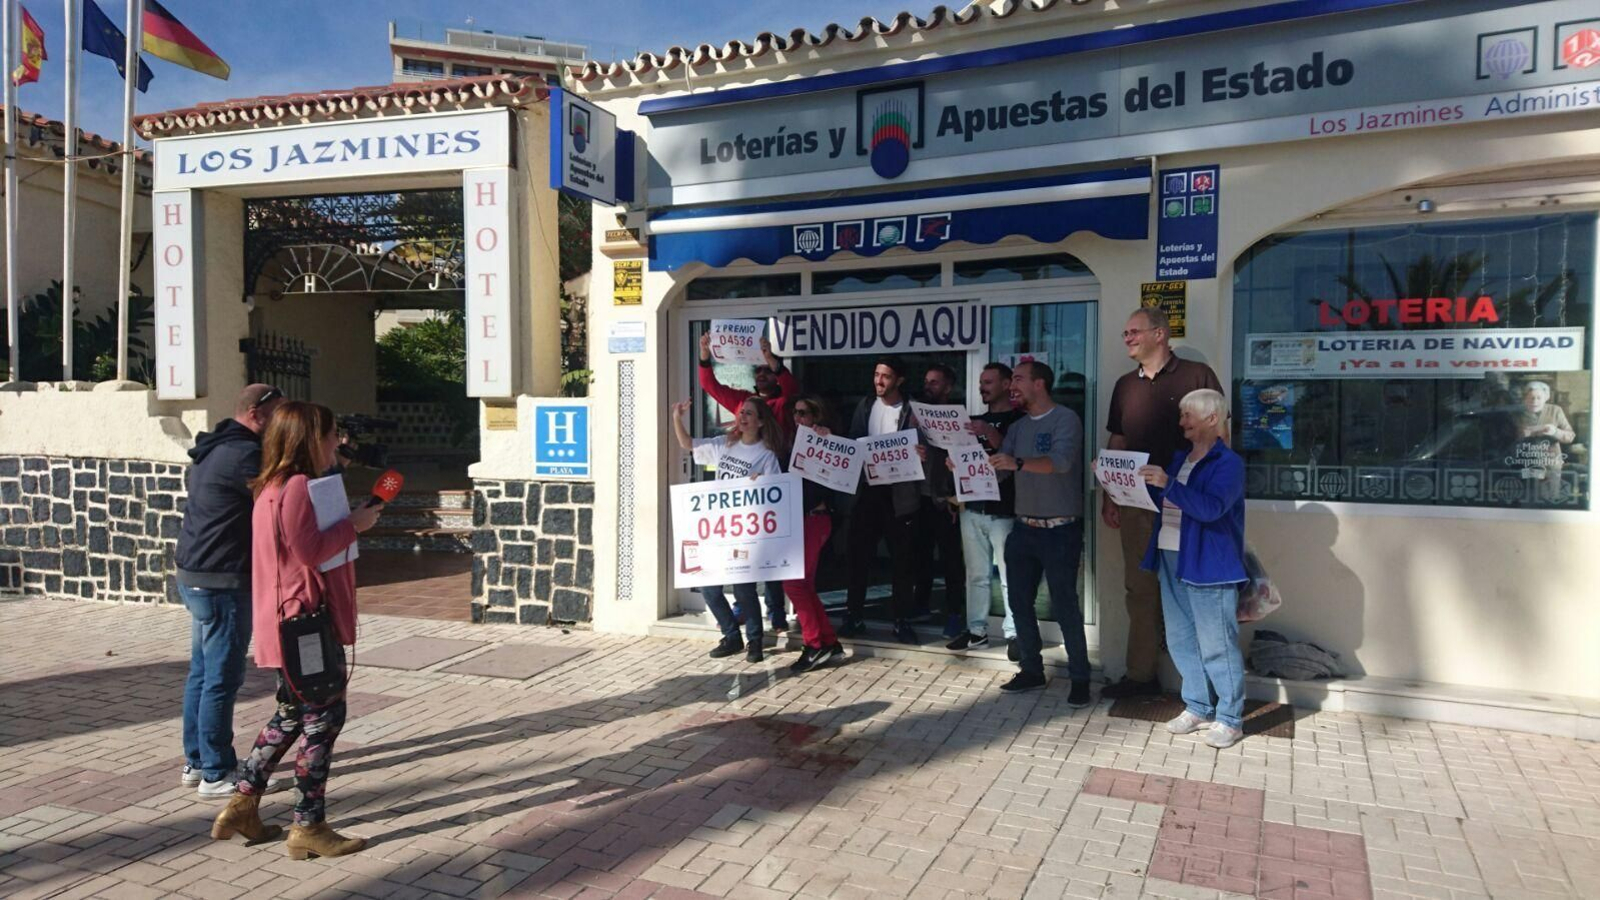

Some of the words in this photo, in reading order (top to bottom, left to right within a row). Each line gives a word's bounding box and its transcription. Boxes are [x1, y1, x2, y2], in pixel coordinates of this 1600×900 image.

[700, 125, 818, 165] Loterías
[829, 127, 846, 159] y
[936, 90, 1108, 142] Apuestas
[1124, 71, 1186, 113] del
[1202, 52, 1354, 103] Estado
[1310, 117, 1347, 135] Los
[1356, 104, 1464, 131] Jazmines
[178, 147, 253, 175] LOS
[263, 130, 481, 173] JAZMINES
[1160, 242, 1195, 252] Loterías
[1197, 243, 1202, 252] y
[1160, 254, 1199, 266] Apuestas
[1201, 252, 1215, 262] del
[1159, 267, 1188, 276] Estado
[304, 275, 316, 293] H
[428, 273, 440, 290] J
[474, 181, 498, 383] HOTEL
[163, 203, 185, 387] HOTEL
[1318, 296, 1499, 326] LOTERIA
[722, 324, 756, 334] PREMIO
[772, 309, 899, 351] VENDIDO
[908, 304, 988, 347] AQUI
[720, 334, 753, 347] 04536
[1318, 338, 1417, 352] LOTERIA
[1424, 337, 1454, 350] DE
[1463, 335, 1574, 349] NAVIDAD
[1340, 359, 1381, 371] ¡Ya
[1416, 358, 1441, 368] la
[1449, 358, 1538, 368] venta!
[925, 409, 959, 418] PREMIO
[544, 411, 578, 444] H
[925, 419, 960, 432] 04536
[816, 437, 856, 456] PREMIO
[874, 436, 909, 450] PREMIO
[806, 446, 850, 469] 04536
[872, 448, 909, 464] 04536
[1105, 457, 1135, 470] PREMIO
[550, 467, 573, 475] PLAYA
[1104, 470, 1136, 488] 04536
[708, 486, 782, 510] PREMIO
[698, 510, 777, 540] 04536
